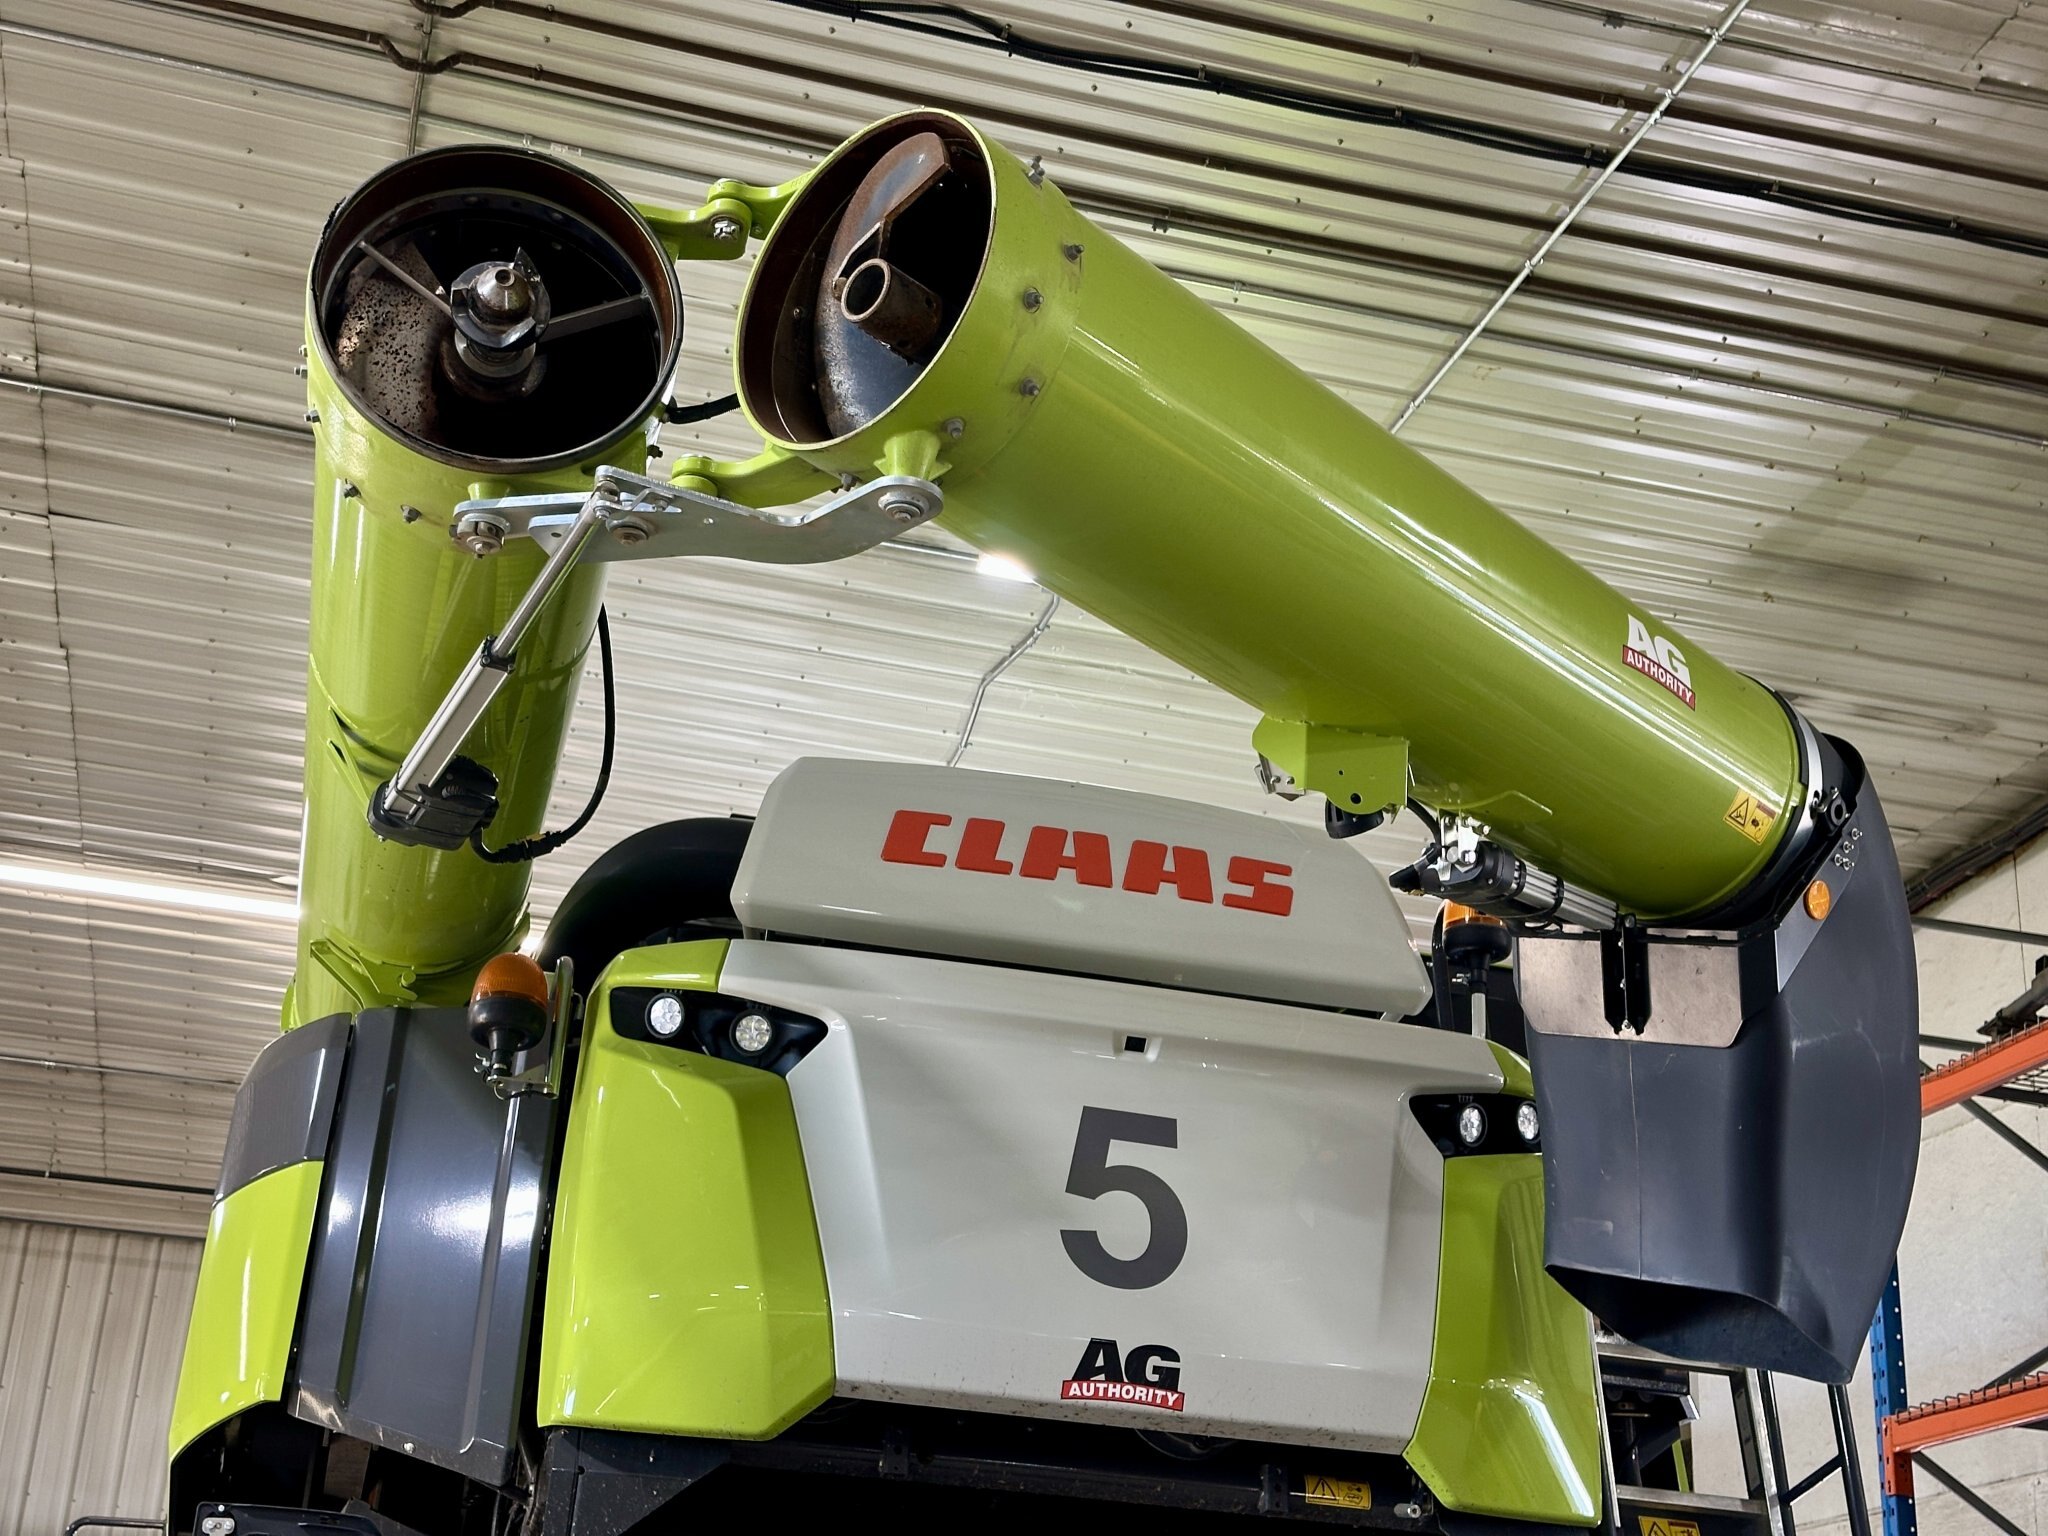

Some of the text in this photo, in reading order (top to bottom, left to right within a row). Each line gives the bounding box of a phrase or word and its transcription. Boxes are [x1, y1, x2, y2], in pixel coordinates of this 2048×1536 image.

[1627, 613, 1692, 690] AG
[1627, 650, 1692, 703] AUTHORITY
[881, 810, 1294, 917] CLAAS
[1060, 1105, 1188, 1290] 5
[1068, 1382, 1180, 1406] AUTHORITY
[1071, 1337, 1181, 1391] AG
